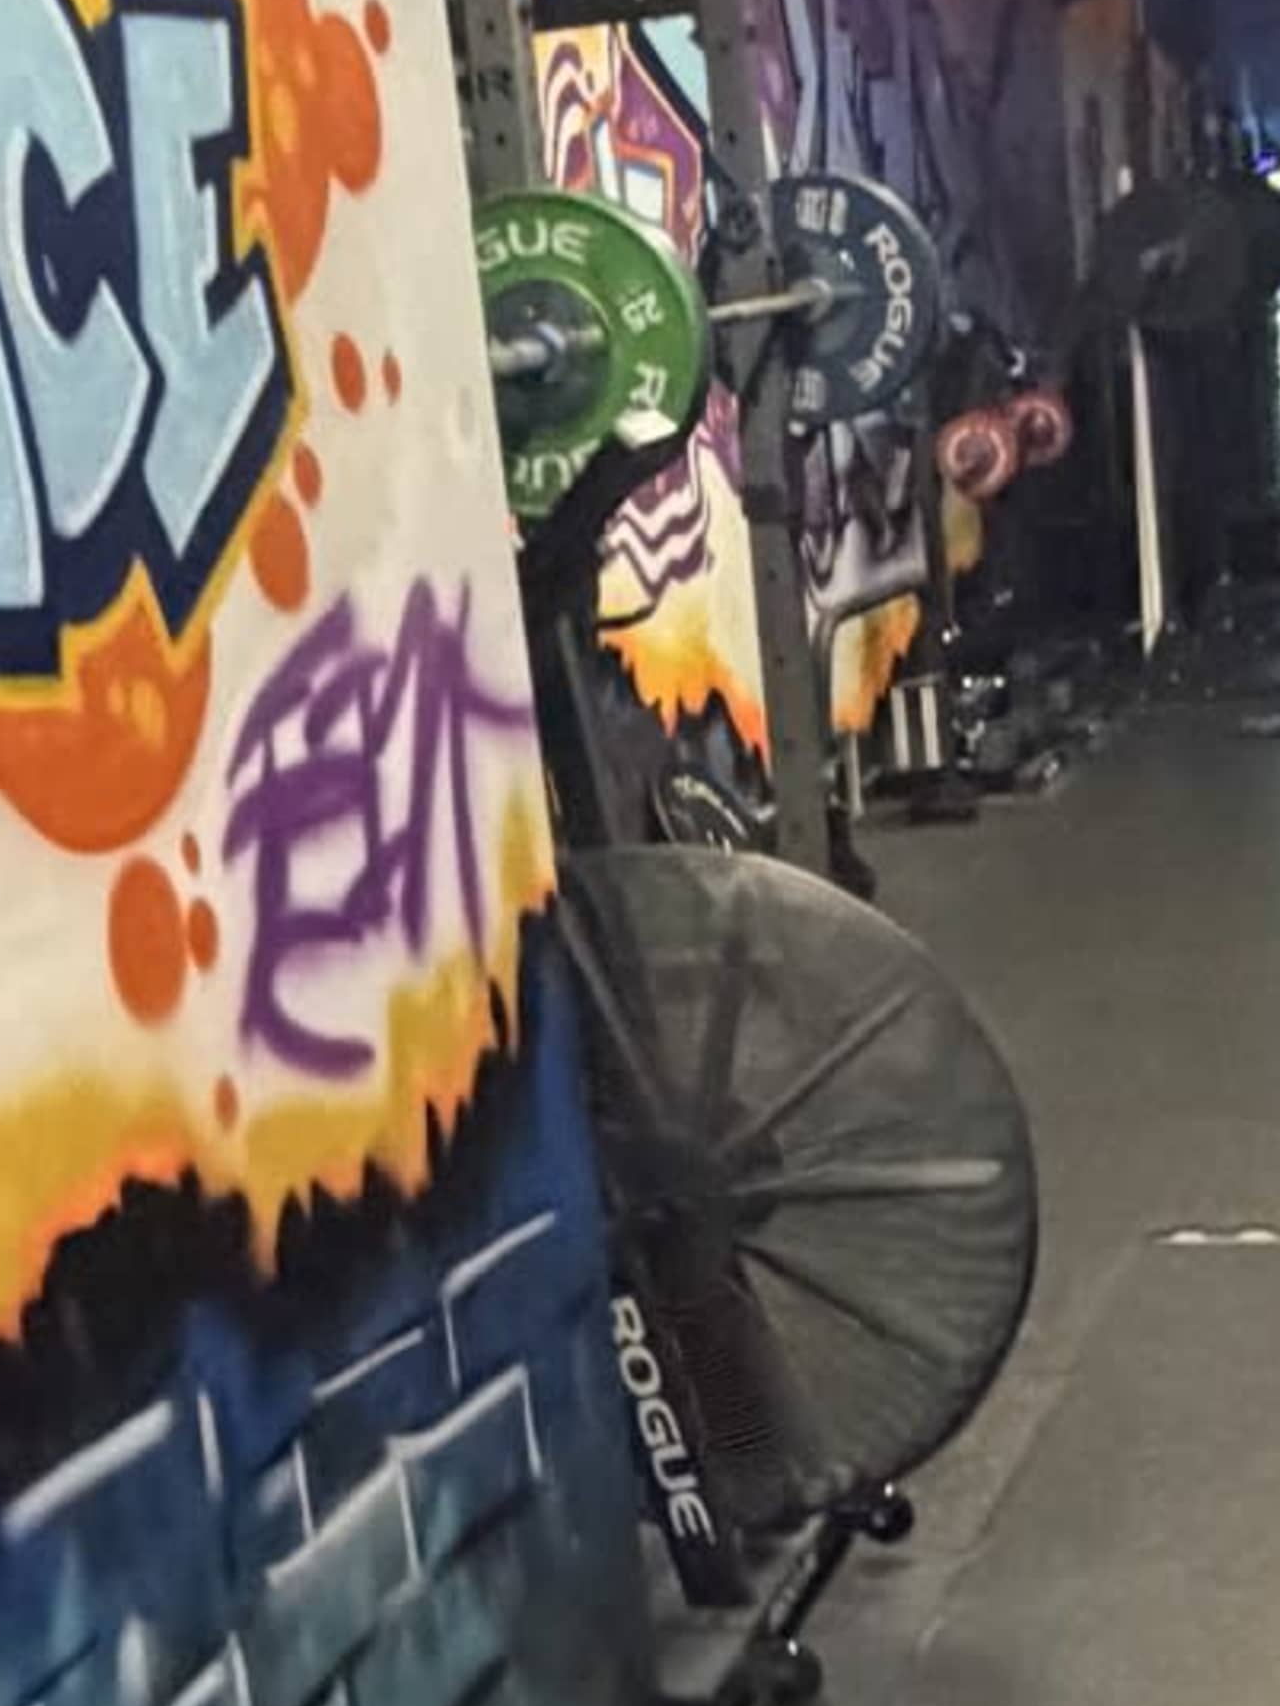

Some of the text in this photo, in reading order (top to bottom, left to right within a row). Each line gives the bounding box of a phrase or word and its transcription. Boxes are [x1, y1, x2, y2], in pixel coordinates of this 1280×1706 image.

[476, 217, 593, 273] GUE
[849, 223, 913, 392] ROGUE
[609, 1294, 718, 1545] ROGUE
